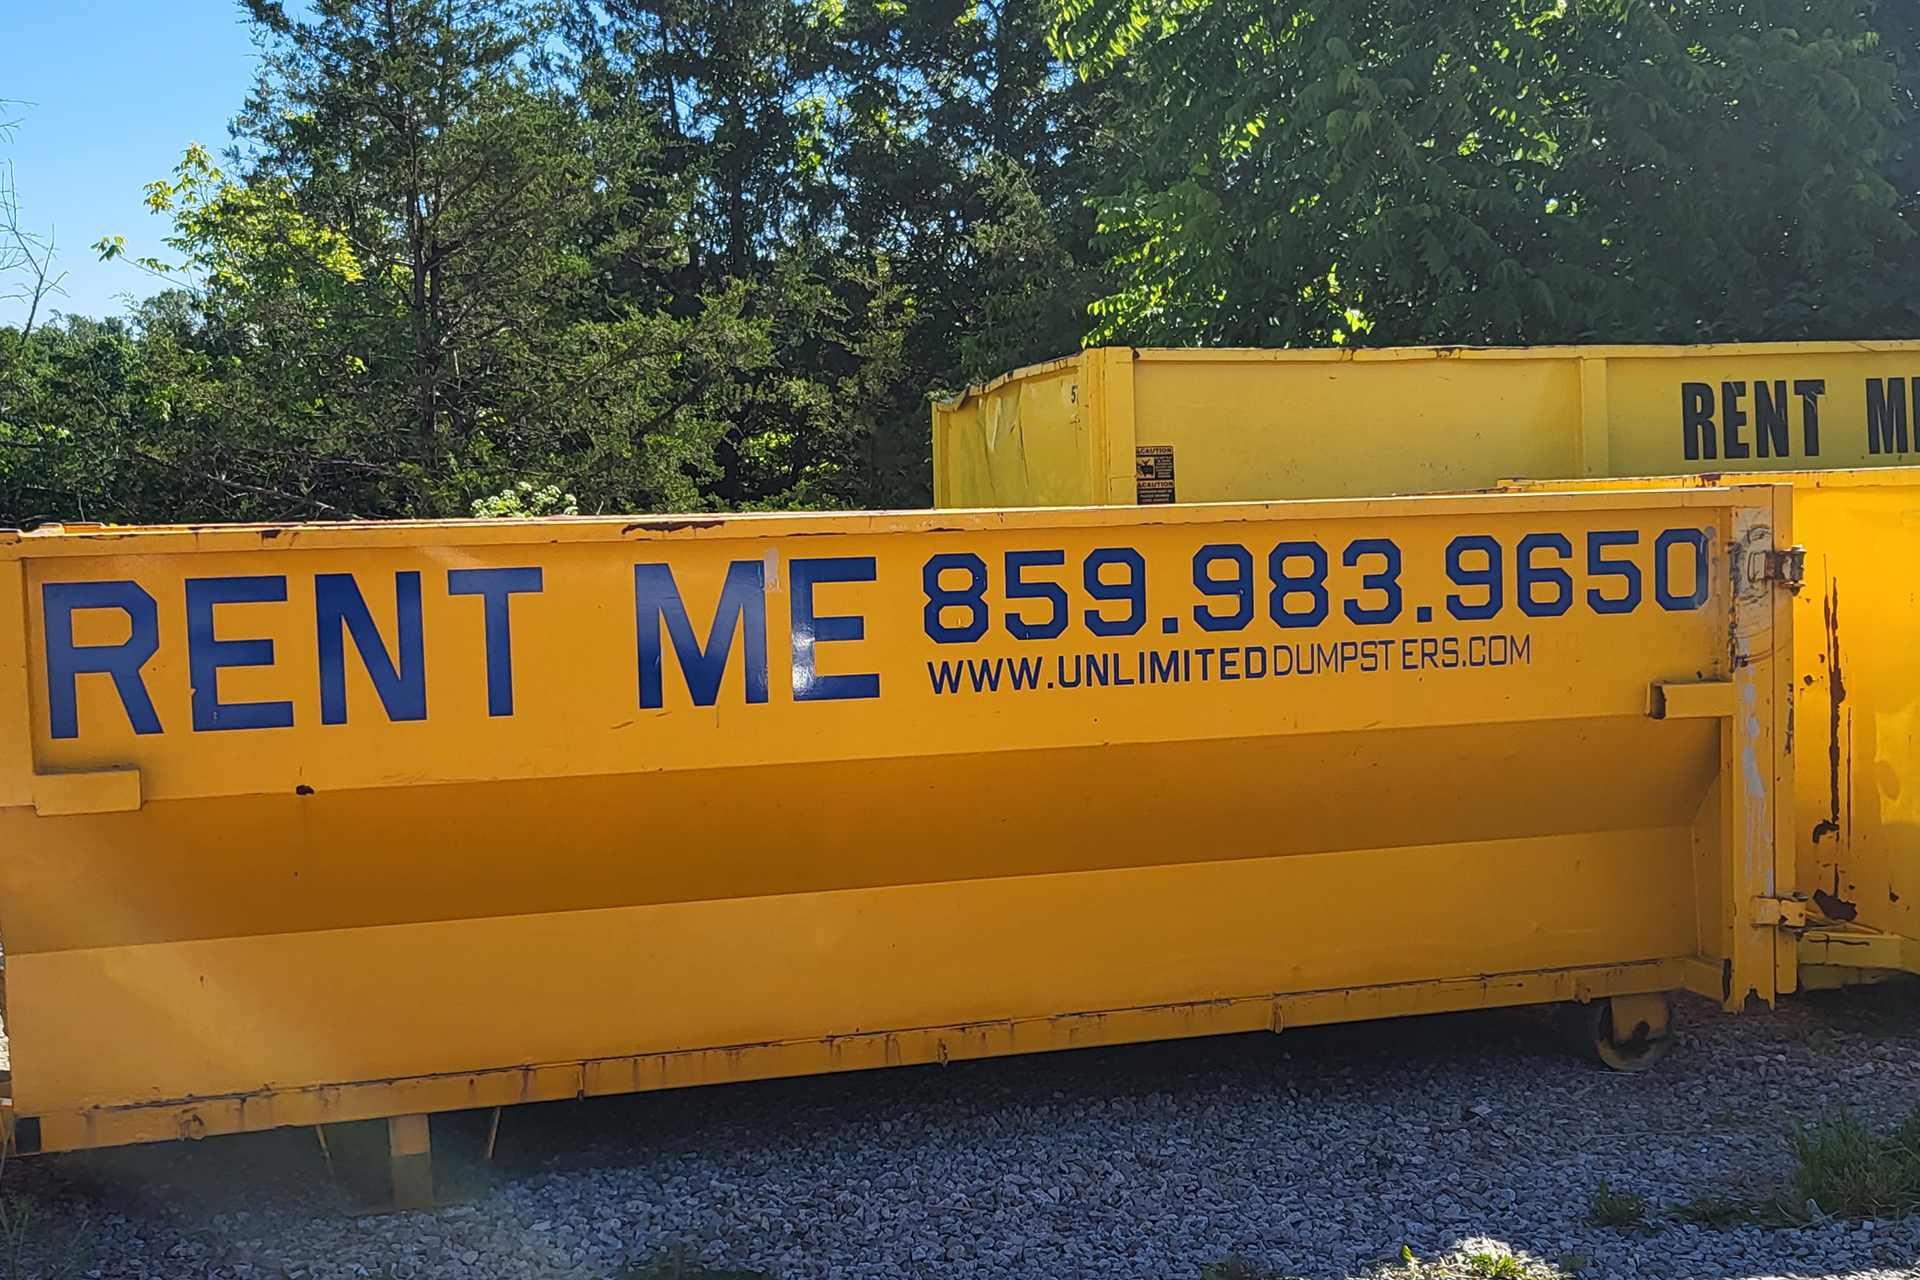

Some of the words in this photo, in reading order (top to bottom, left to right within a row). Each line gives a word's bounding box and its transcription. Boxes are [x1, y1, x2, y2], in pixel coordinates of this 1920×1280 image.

[1681, 379, 1825, 461] RENT
[922, 528, 1709, 645] 859.983.9650
[41, 566, 543, 740] RENT
[634, 556, 881, 710] ME
[927, 633, 1532, 695] WWW.UNLIMITEDDUMPSTERS.COM
